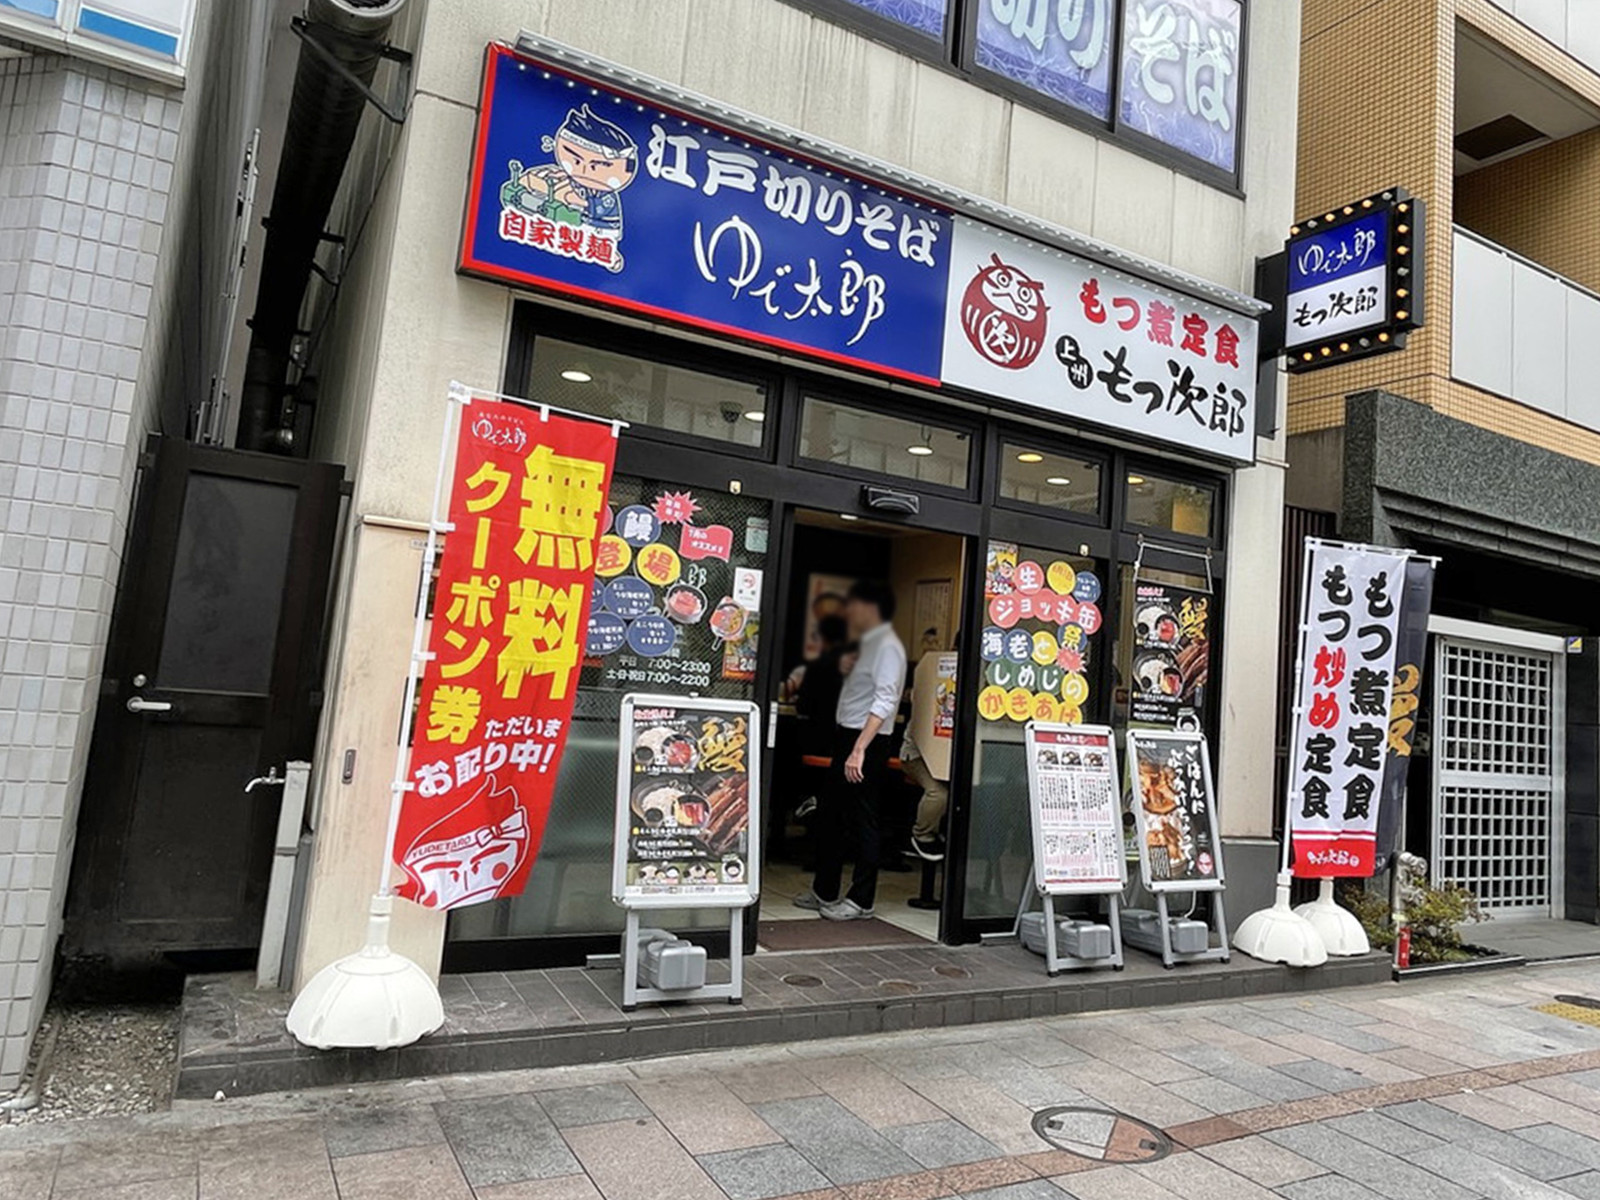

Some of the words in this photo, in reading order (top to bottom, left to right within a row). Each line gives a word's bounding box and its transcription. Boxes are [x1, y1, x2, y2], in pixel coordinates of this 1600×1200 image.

[646, 123, 940, 268] 江戸切りそば
[501, 209, 617, 269] 自家製麺
[1297, 228, 1377, 277] ゆで太郎
[694, 216, 887, 345] ゆで太郎
[1293, 285, 1379, 327] もつ次郎
[1080, 278, 1241, 368] もつ煮定食
[1097, 346, 1247, 438] もつ次郎
[472, 418, 528, 453] ゆで太郎
[496, 443, 607, 701] 無料
[1019, 566, 1040, 590] 生
[425, 460, 515, 746] クーポン券
[995, 598, 1098, 632] ジョッキ缶
[982, 630, 1051, 659] 海老と
[984, 694, 1079, 723] かきあげ
[1300, 564, 1354, 821] もつ炒め定食
[1343, 571, 1394, 822] もつ煮定食
[485, 715, 564, 741] ただいま
[414, 736, 557, 799] お配り中!
[1185, 744, 1206, 816] ごはんに
[412, 836, 473, 859] YUDETARO
